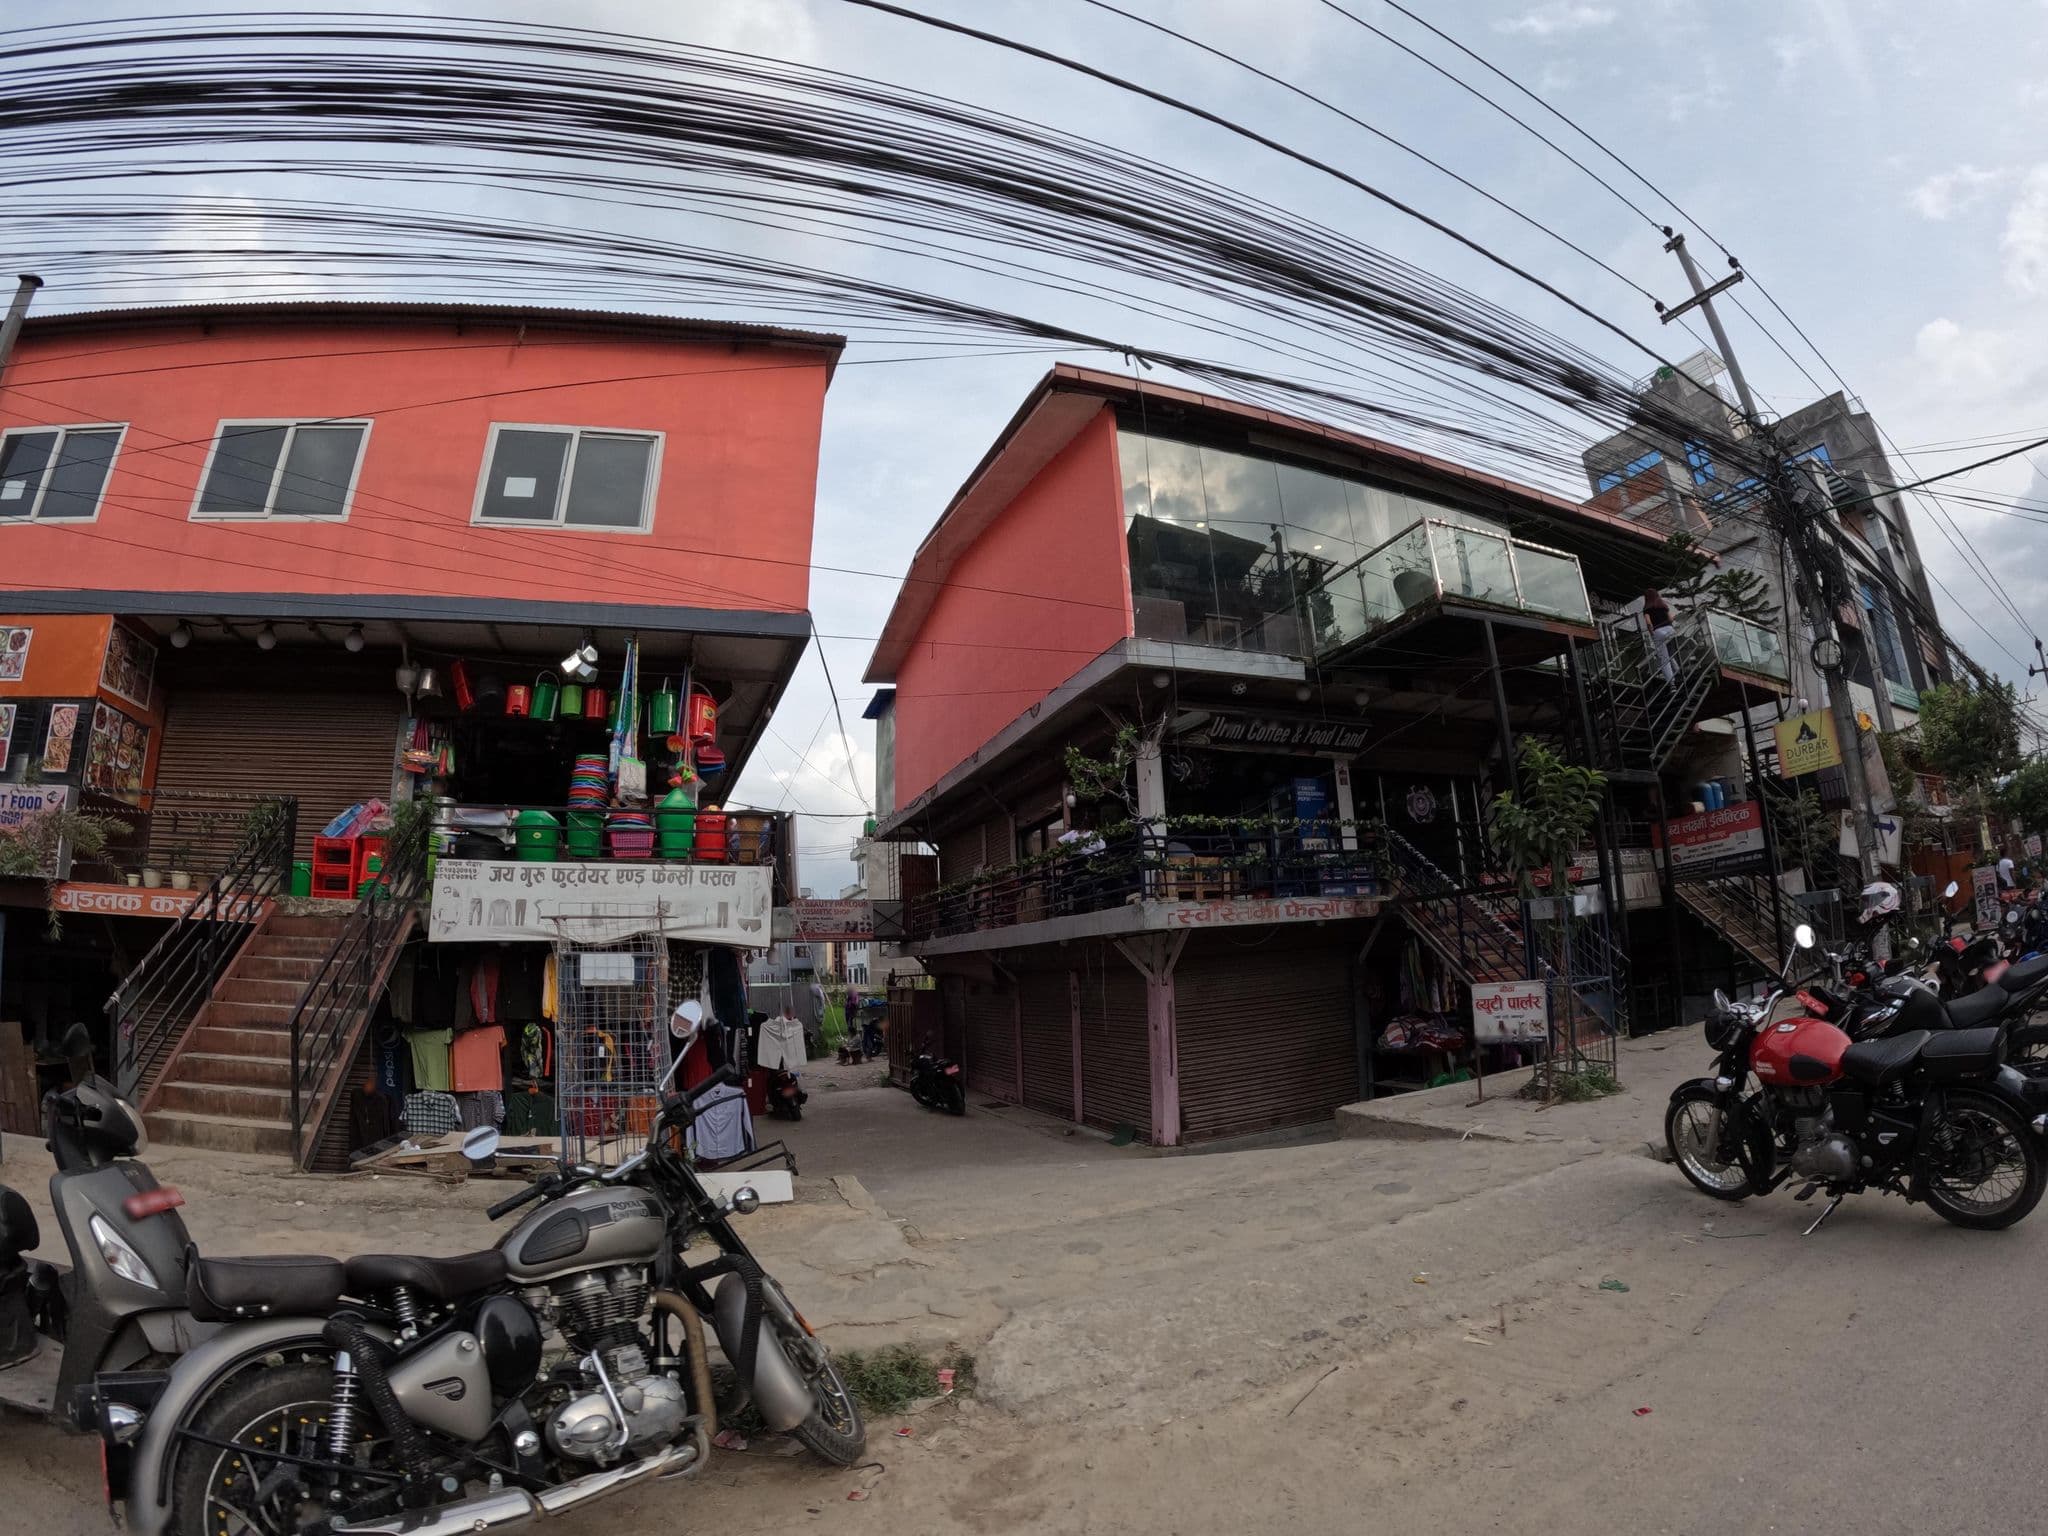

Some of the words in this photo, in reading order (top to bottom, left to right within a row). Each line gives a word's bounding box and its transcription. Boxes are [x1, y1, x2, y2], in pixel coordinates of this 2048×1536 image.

[1291, 727, 1302, 744] &
[1334, 726, 1368, 748] Land
[1786, 738, 1830, 760] DURBAR
[11, 794, 43, 811] FOOD
[488, 866, 516, 882] जय
[700, 870, 737, 887] पसल
[60, 889, 144, 911] गुडलक
[1507, 992, 1543, 1010] पार्लर
